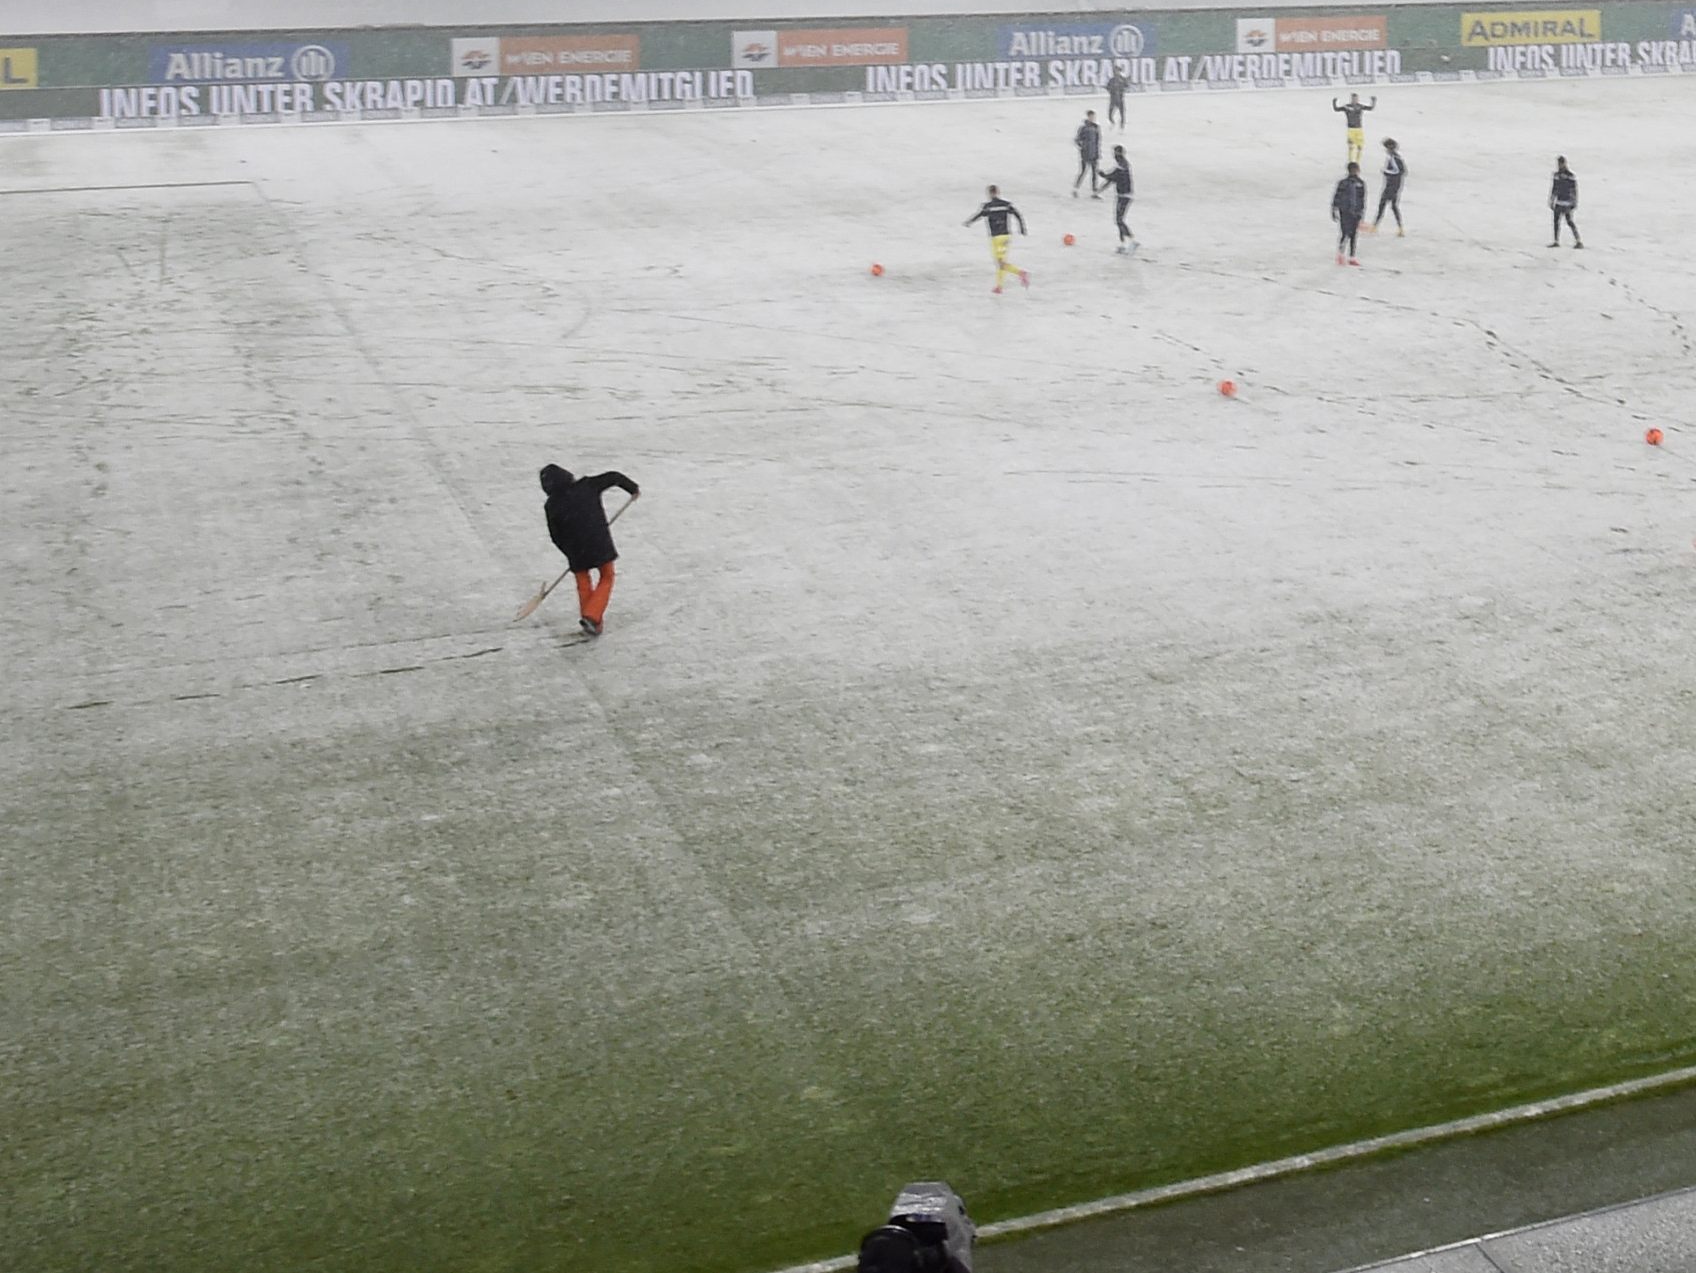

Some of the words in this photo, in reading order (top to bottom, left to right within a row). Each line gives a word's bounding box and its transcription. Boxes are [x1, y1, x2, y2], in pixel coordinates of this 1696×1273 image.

[1467, 17, 1597, 42] ADMIRAL
[559, 49, 633, 64] ENERGIE
[832, 42, 899, 58] ENERGIE
[1008, 31, 1103, 58] Allianz
[1486, 45, 1556, 71] INFOS
[1560, 41, 1632, 69] UNTER
[165, 51, 285, 81] Allianz
[865, 64, 947, 93] INFOS
[955, 60, 1041, 90] UNTER
[100, 84, 201, 119] INFOS
[209, 82, 314, 115] UNTER
